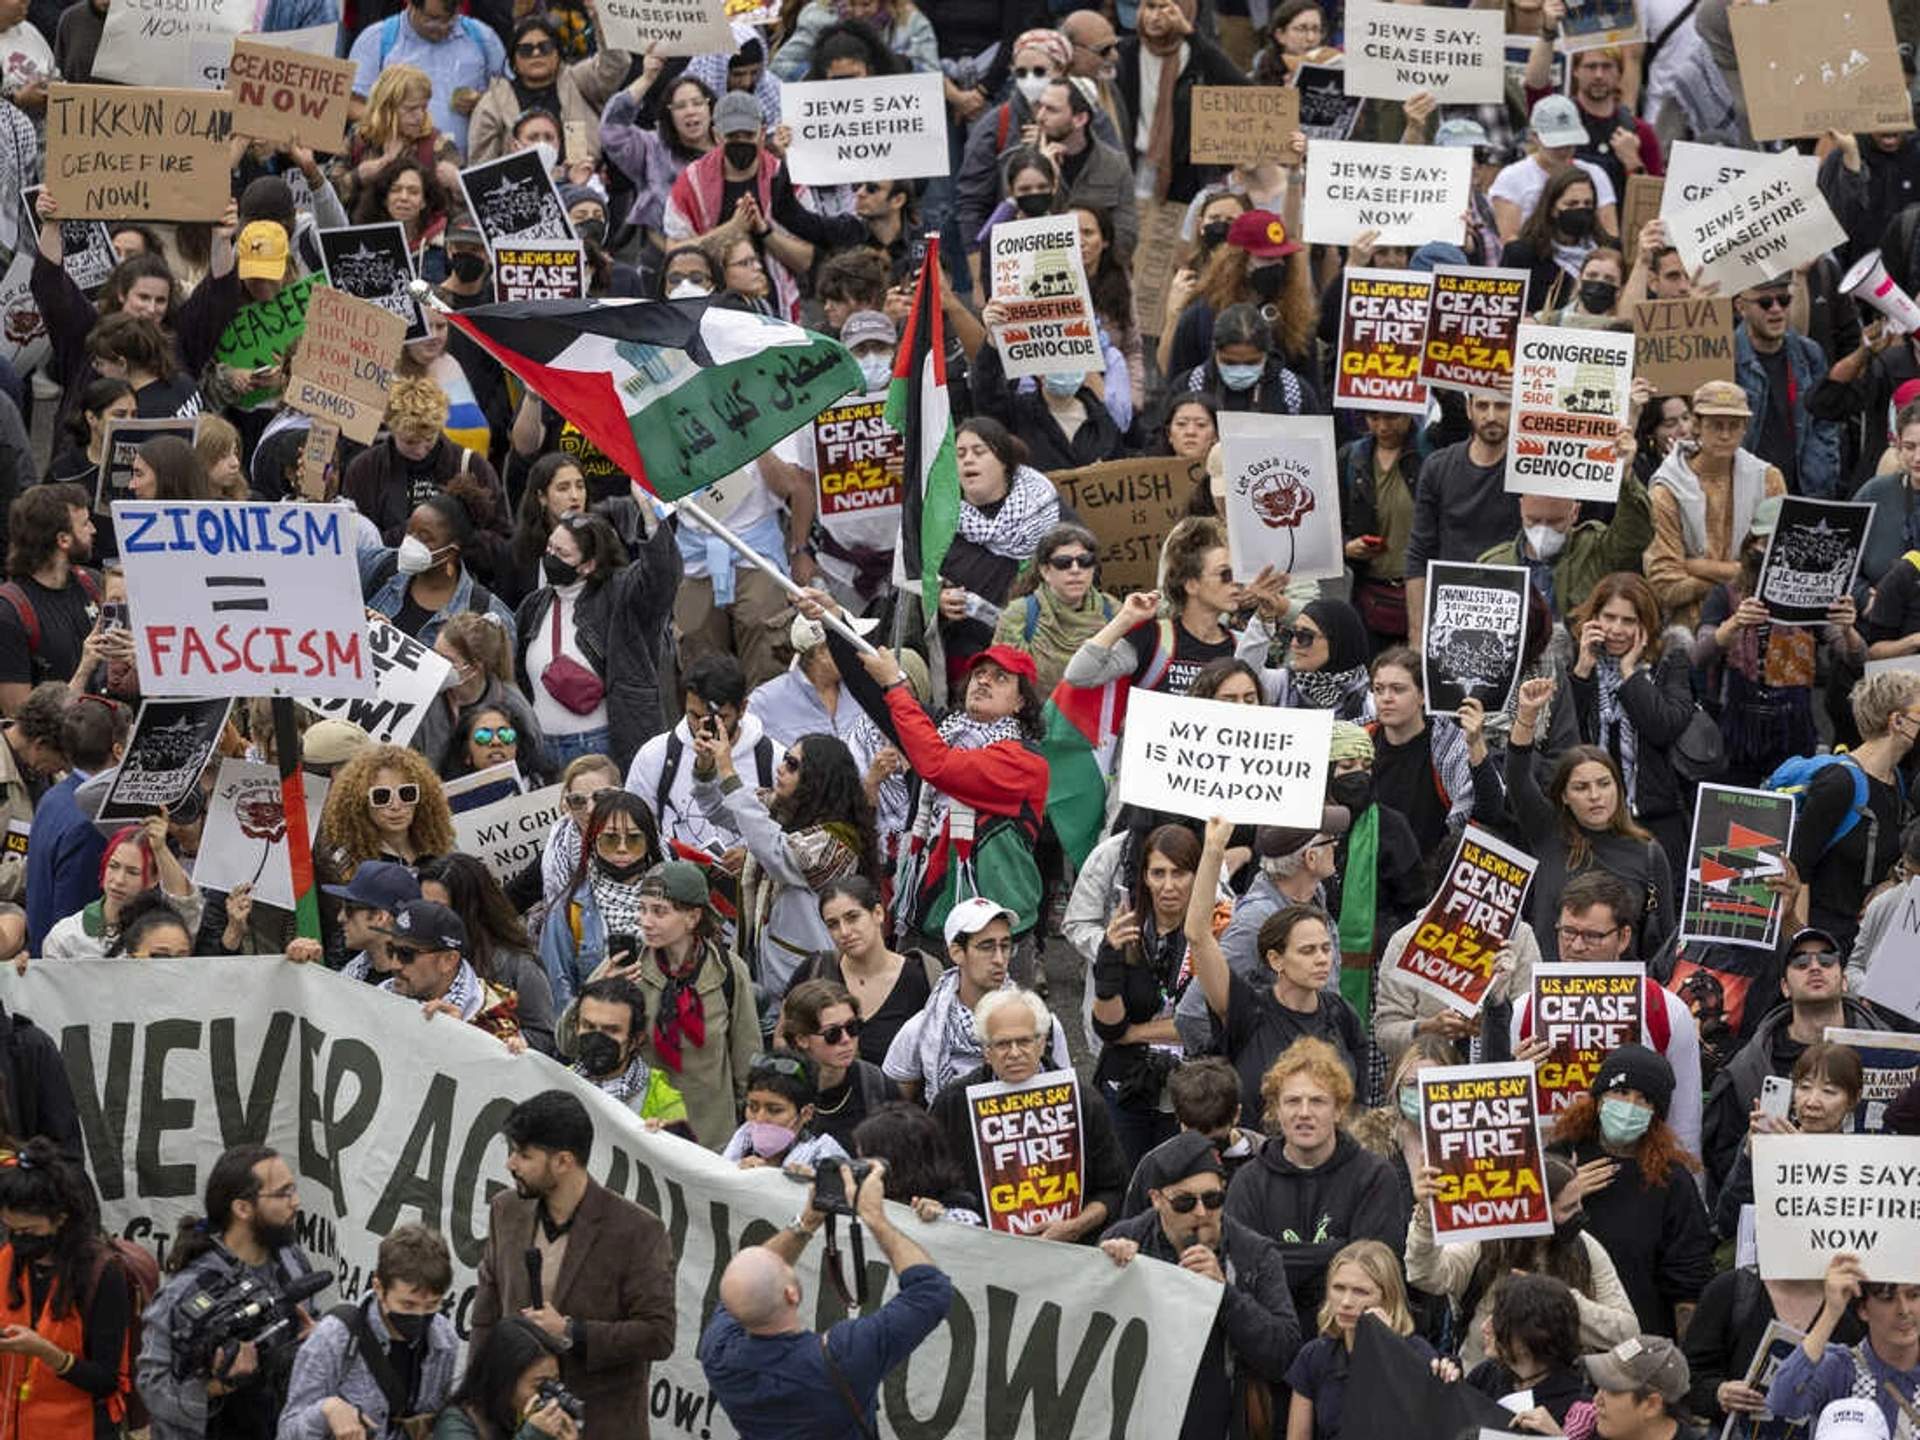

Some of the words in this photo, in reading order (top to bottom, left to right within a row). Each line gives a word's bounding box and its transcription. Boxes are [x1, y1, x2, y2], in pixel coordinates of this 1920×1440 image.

[607, 3, 708, 23] CEASEFIRE
[637, 26, 683, 41] NOW
[1368, 22, 1426, 41] JEWS
[1434, 28, 1482, 45] SAY:
[1364, 44, 1483, 67] CEASEFIRE
[230, 52, 349, 97] CEASEFIRE
[1397, 68, 1451, 87] NOW
[239, 82, 329, 120] NOW
[803, 99, 864, 117] JEWS
[872, 95, 921, 112] SAY:
[1201, 91, 1287, 116] GENOCIDE
[53, 97, 164, 138] TIKKUN
[802, 117, 925, 140] CEASEFIRE
[838, 143, 893, 160] NOW
[62, 153, 194, 178] CEASEFIRE
[1330, 162, 1392, 180] JEWS
[1401, 167, 1448, 182] SAY:
[86, 182, 151, 210] NOW!
[1327, 185, 1448, 204] CEASEFIRE
[1359, 210, 1414, 225] NOW
[1695, 204, 1745, 244] JEWS
[1748, 180, 1793, 212] SAY:
[1702, 198, 1808, 264] CEASEFIRE
[1740, 234, 1789, 266] NOW
[500, 266, 578, 286] CEASE
[1459, 279, 1495, 293] JEWS
[1499, 280, 1521, 294] SAY
[1371, 283, 1406, 297] JEWS
[1008, 300, 1083, 320] EASEFIRE
[1349, 296, 1428, 322] CEASE
[1436, 291, 1520, 316] CEASE
[1636, 300, 1719, 332] VIVA
[218, 281, 312, 354] CEASEF
[1439, 314, 1509, 339] FIRE
[1029, 324, 1064, 339] NOT
[1354, 320, 1423, 345] FIRE
[1464, 336, 1481, 347] IN
[1378, 343, 1396, 353] IN
[1427, 341, 1513, 370] GAZA
[1636, 333, 1731, 366] PALESTINA
[354, 359, 393, 392] LOVE
[1435, 363, 1502, 385] NOW!
[1522, 365, 1556, 378] PICK
[1351, 377, 1413, 398] NOW!
[302, 386, 356, 420] BOMBS
[836, 407, 872, 421] JEWS
[828, 438, 894, 464] FIRE
[1547, 440, 1588, 459] NOT
[1248, 458, 1280, 475] Gaza
[1285, 460, 1311, 478] Live
[834, 487, 895, 510] NOW!
[120, 506, 341, 554] ZIONISM
[1441, 611, 1470, 626] SAY
[1475, 614, 1513, 631] JEWS
[146, 624, 363, 679] FASCISM
[1170, 721, 1207, 742] MY
[1217, 728, 1293, 750] GRIEF
[1146, 742, 1167, 762] IS
[1177, 749, 1231, 772] NOT
[1240, 757, 1311, 779] YOUR
[1167, 772, 1283, 802] WEAPON
[477, 821, 510, 846] MY
[519, 807, 560, 834] GRI
[494, 839, 545, 867] NOT
[1479, 852, 1509, 878] JEWS
[1506, 866, 1528, 887] SAY
[1451, 862, 1520, 914] CEASE
[1443, 891, 1511, 939] FIRE
[1459, 925, 1478, 940] IN
[1414, 922, 1498, 980] GAZA
[1408, 951, 1475, 993] NOW!
[1564, 978, 1607, 993] JEWS
[1609, 978, 1636, 993] SAY
[1540, 995, 1637, 1021] CEASE
[1548, 1024, 1628, 1049] FIRE
[1579, 1050, 1599, 1060] IN
[1001, 1092, 1044, 1112] JEWS
[1046, 1085, 1073, 1104] SAY
[1452, 1081, 1497, 1099] JEWS
[1499, 1079, 1527, 1097] SAY
[980, 1103, 1077, 1144] CEASE
[1429, 1098, 1531, 1131] CEASE
[992, 1132, 1074, 1171] FIRE
[1440, 1128, 1525, 1160] FIRE
[1027, 1164, 1048, 1179] IN
[1474, 1158, 1495, 1171] IN
[1776, 1164, 1848, 1185] JEWS
[991, 1170, 1080, 1213] GAZA
[1437, 1168, 1542, 1202] GAZA
[1007, 1202, 1073, 1235] NOW!
[1452, 1198, 1530, 1226] NOW!
[1775, 1196, 1920, 1219] CEASEFIRE
[1811, 1229, 1878, 1250] NOW
[651, 1378, 718, 1440] OW!
